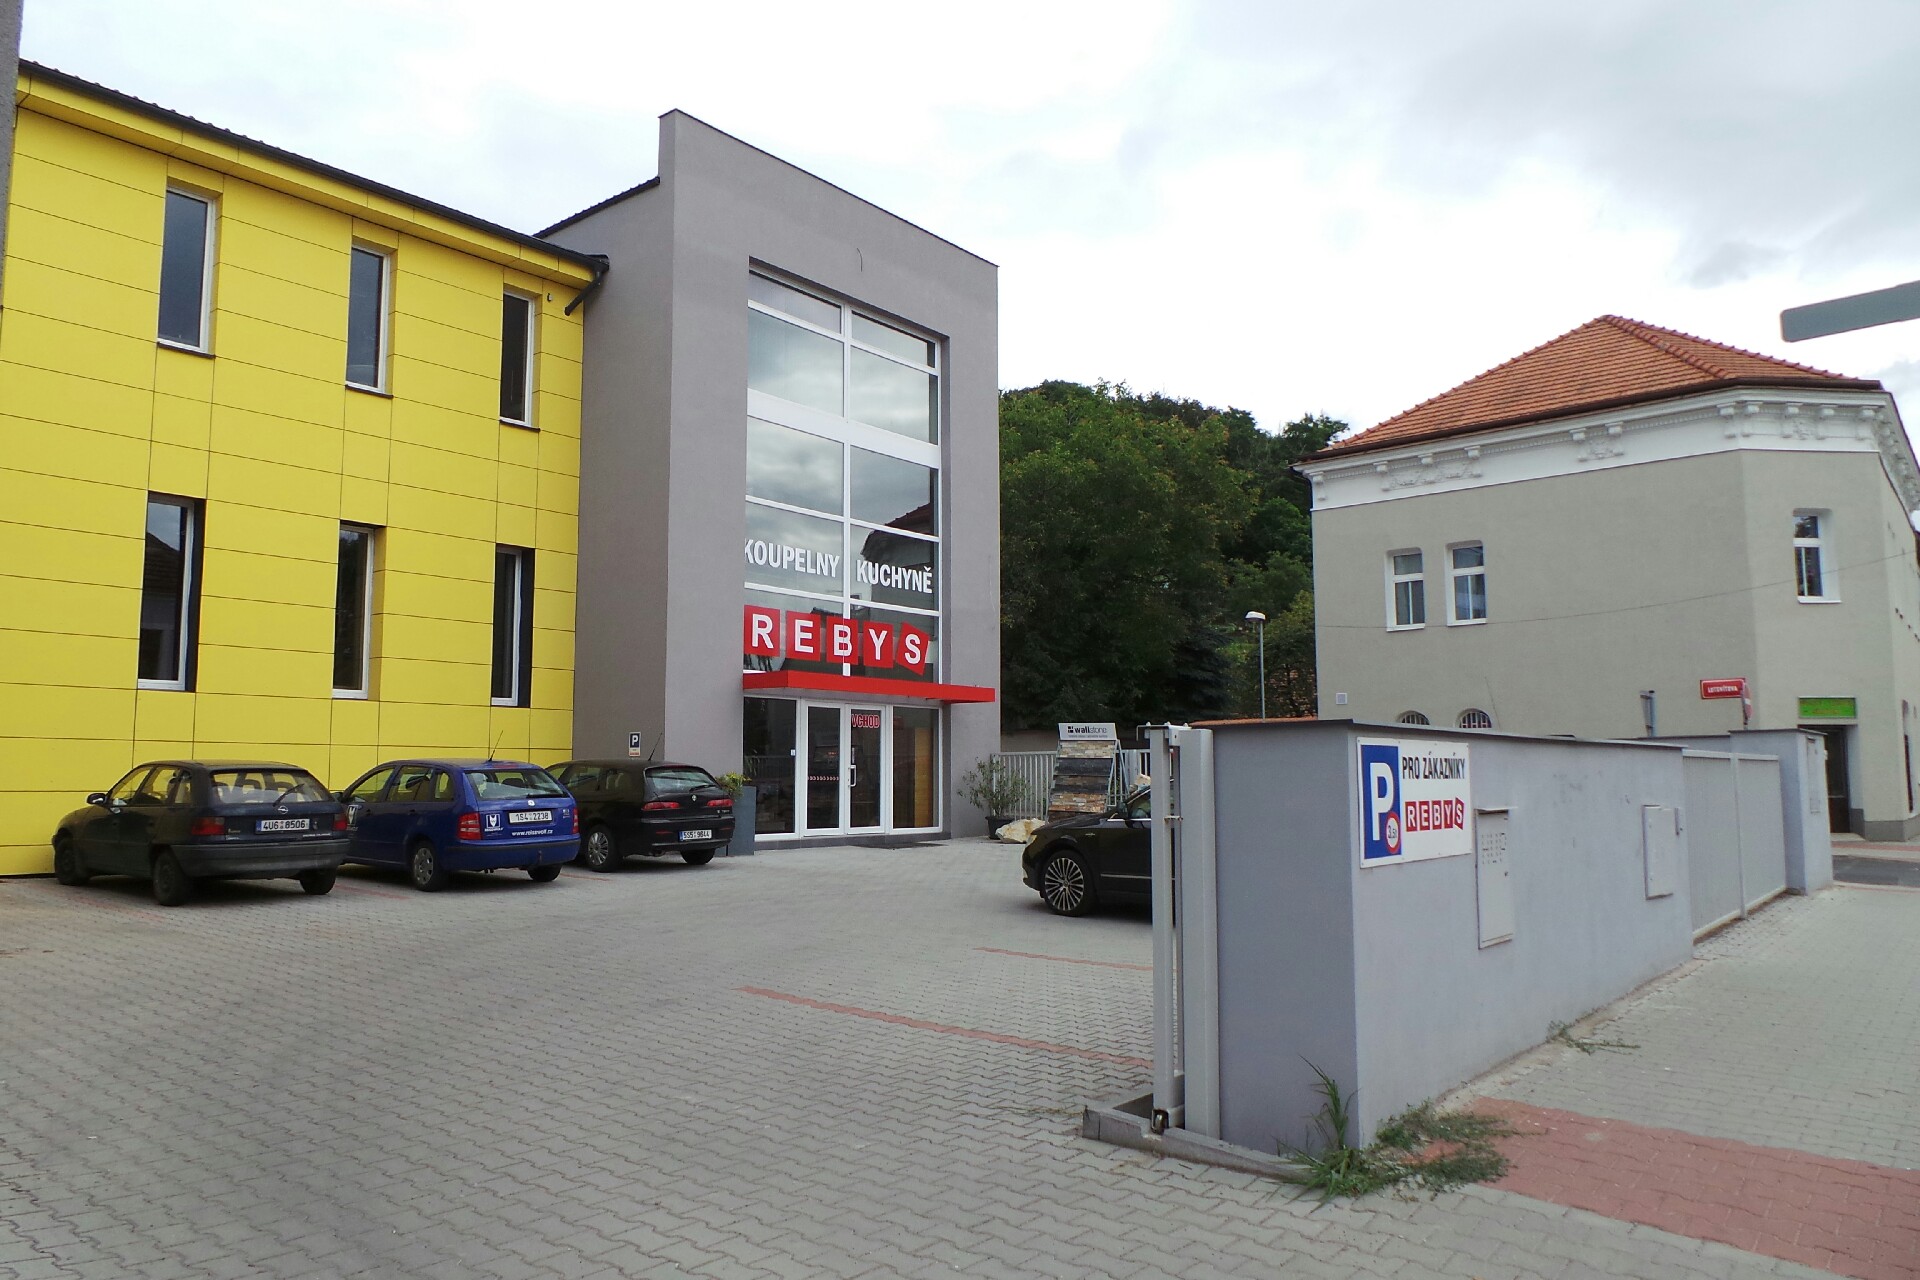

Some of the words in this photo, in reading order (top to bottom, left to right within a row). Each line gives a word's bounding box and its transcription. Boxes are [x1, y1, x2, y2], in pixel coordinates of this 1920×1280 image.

[745, 538, 840, 578] KOUPELNY
[856, 559, 933, 594] KUCHYNĚ
[751, 613, 922, 665] REBYS
[851, 714, 880, 728] VCHOD
[631, 734, 639, 746] P
[1402, 756, 1420, 780] PRO
[1422, 751, 1466, 780] ZÁKAZNÍKY
[1369, 762, 1395, 841] P
[263, 821, 279, 830] 4U6
[284, 820, 306, 829] 8506
[533, 812, 549, 821] 2238
[1406, 803, 1463, 829] REBYS
